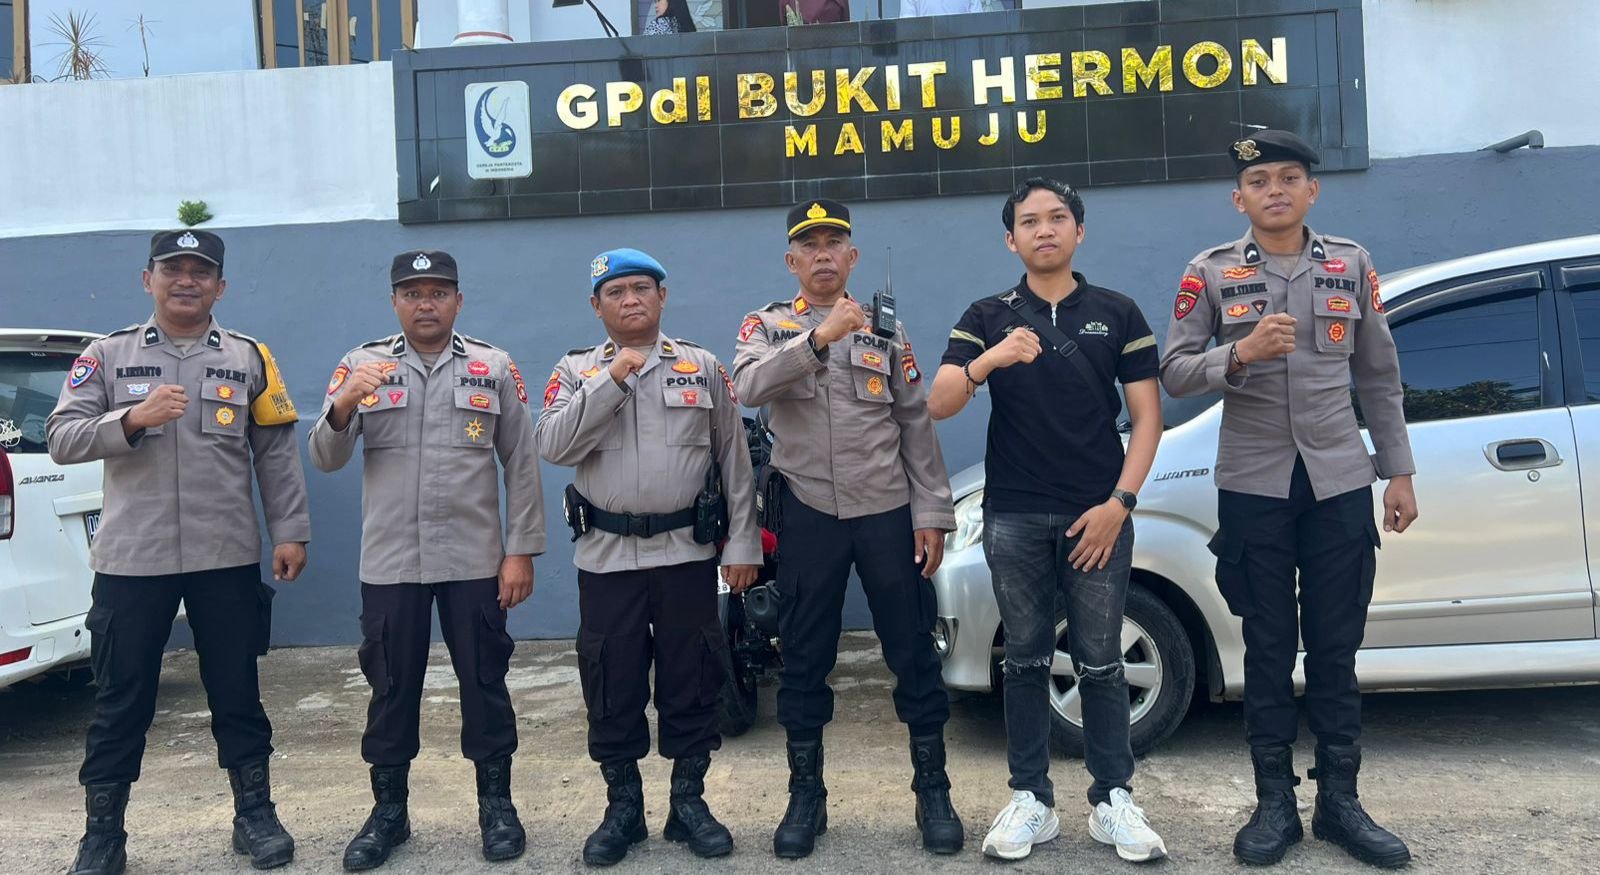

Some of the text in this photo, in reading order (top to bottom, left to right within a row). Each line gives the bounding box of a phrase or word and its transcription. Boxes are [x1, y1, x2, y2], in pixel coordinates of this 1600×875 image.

[556, 37, 1288, 130] GPdI BUKIT HERMON
[785, 109, 1047, 157] MAMUJU
[1314, 277, 1356, 292] POLRI
[854, 334, 889, 352] POLRI
[206, 367, 247, 383] POLRI
[666, 376, 707, 387] POLRI
[460, 377, 496, 389] POLRI
[19, 474, 65, 485] AVANZA
[1153, 468, 1209, 481] LIMITED
